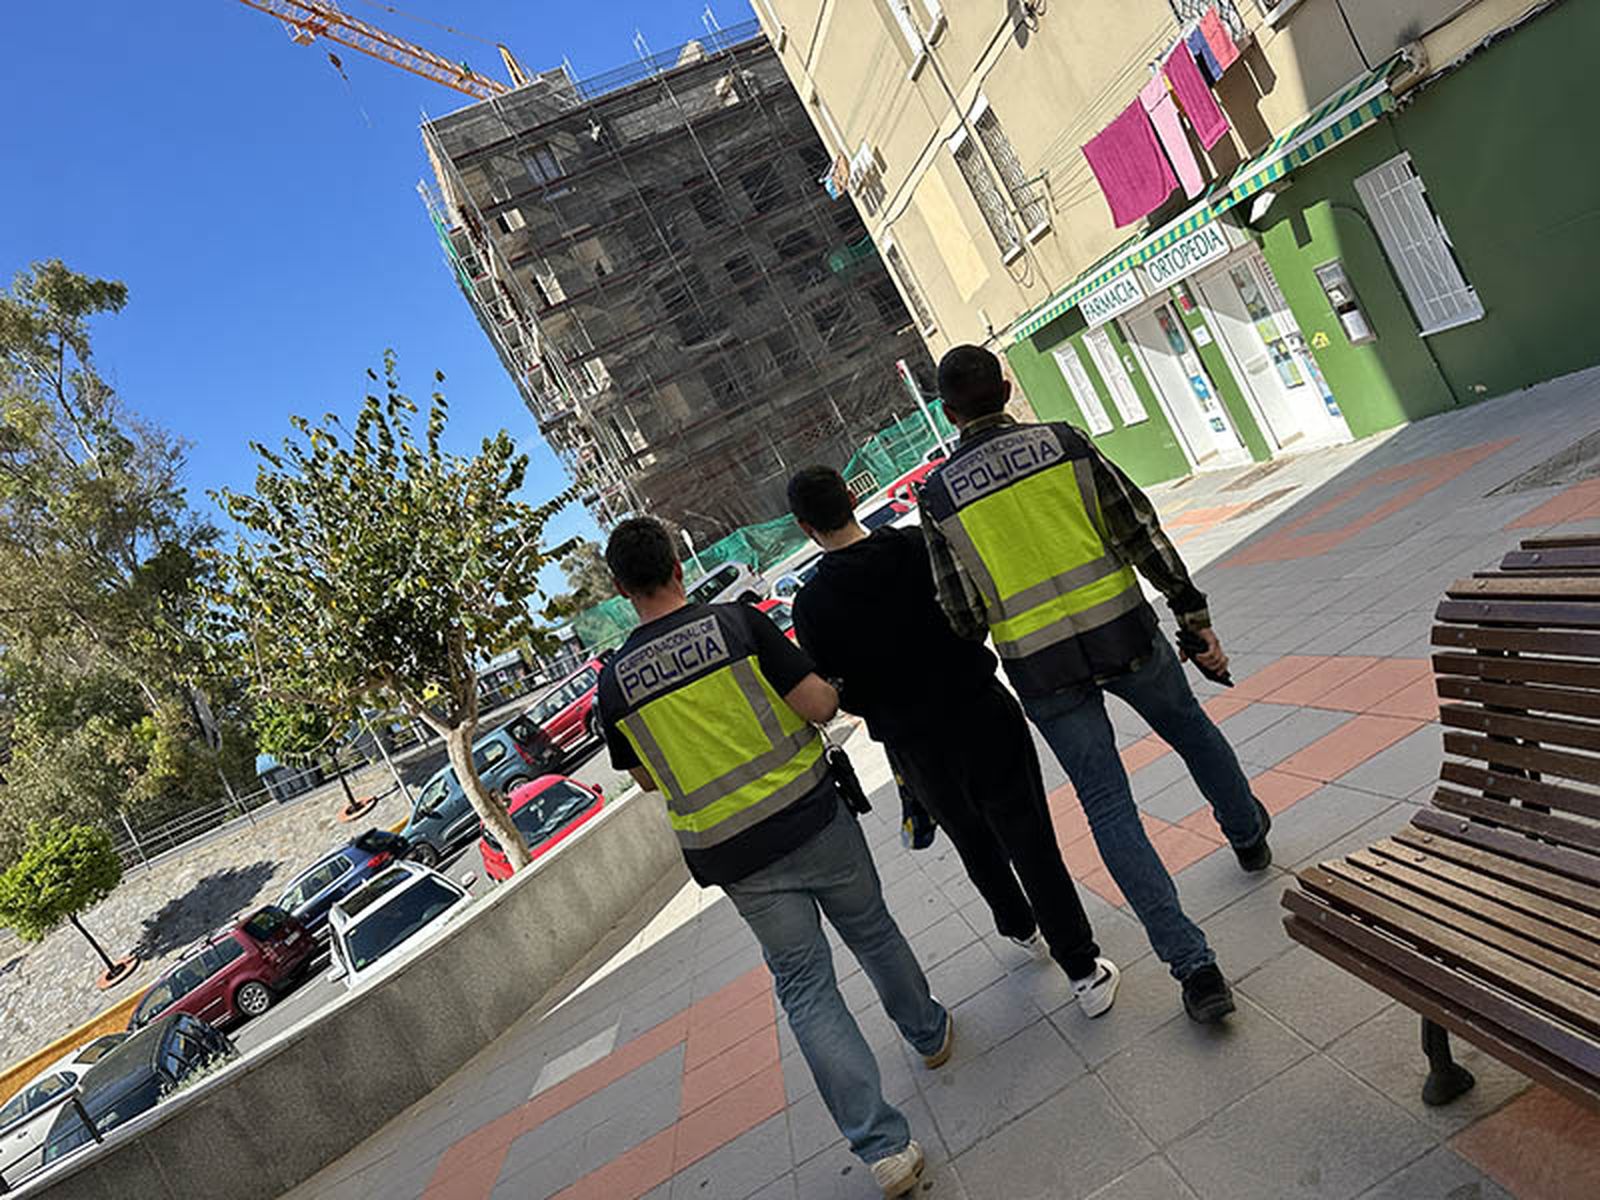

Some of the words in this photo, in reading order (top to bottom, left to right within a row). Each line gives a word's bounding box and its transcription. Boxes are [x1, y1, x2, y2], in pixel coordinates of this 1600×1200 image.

[1148, 227, 1224, 283] ORTOPEDIA
[1082, 279, 1139, 322] FARMACIA
[951, 440, 1058, 499] POLICIA
[622, 636, 722, 698] POLICIA
